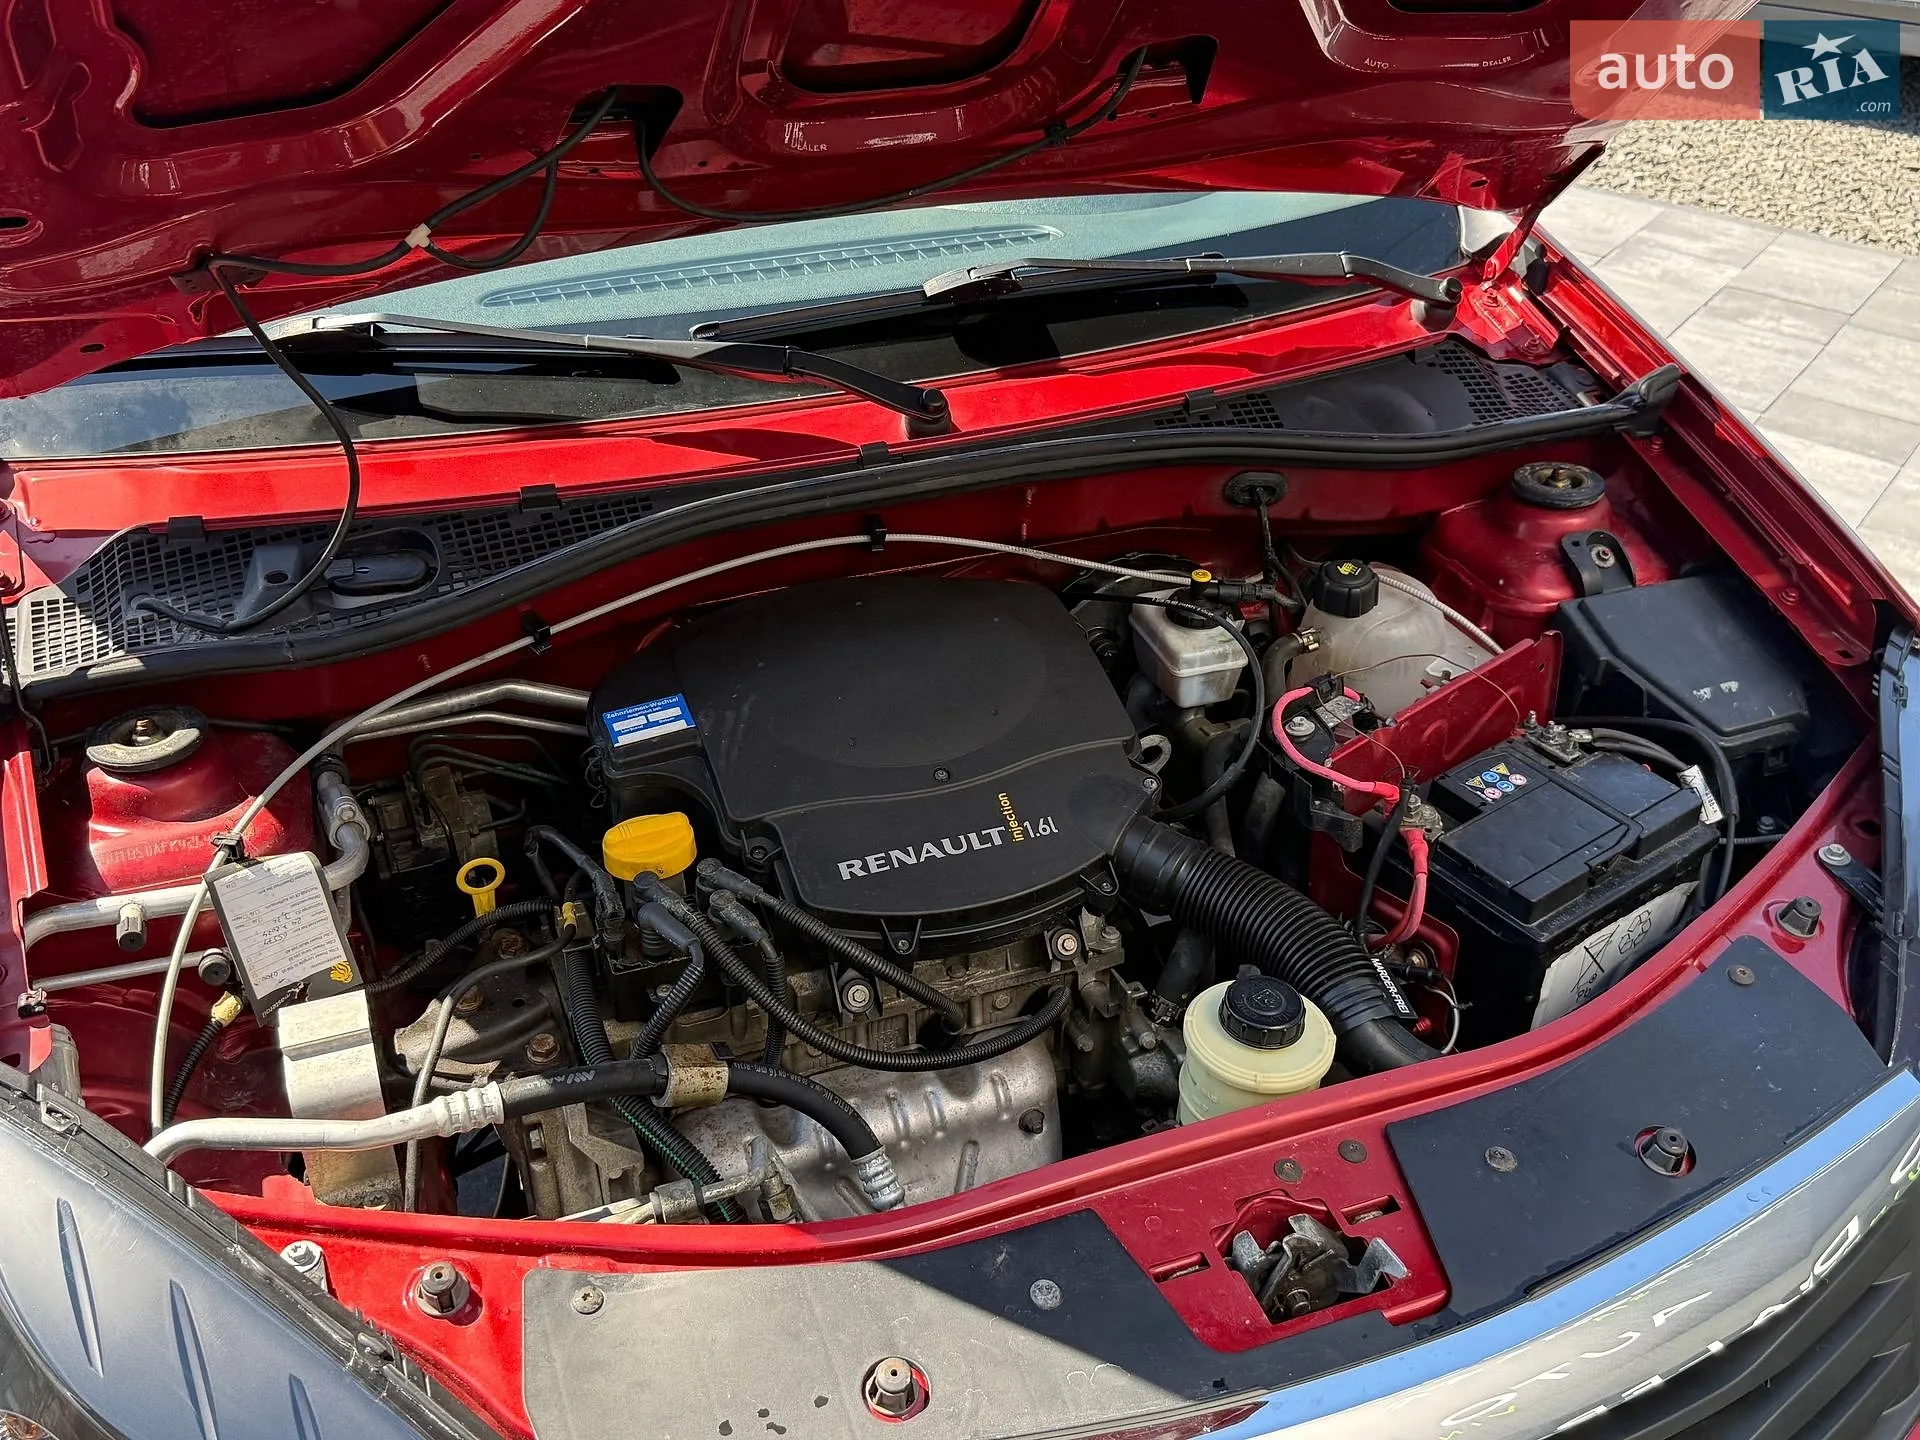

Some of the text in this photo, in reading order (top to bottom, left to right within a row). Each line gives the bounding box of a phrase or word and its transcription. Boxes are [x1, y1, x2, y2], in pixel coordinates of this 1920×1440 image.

[998, 792, 1025, 842] injection
[837, 826, 1006, 881] RENAULT
[1370, 957, 1411, 1014] MARDER-FREI
